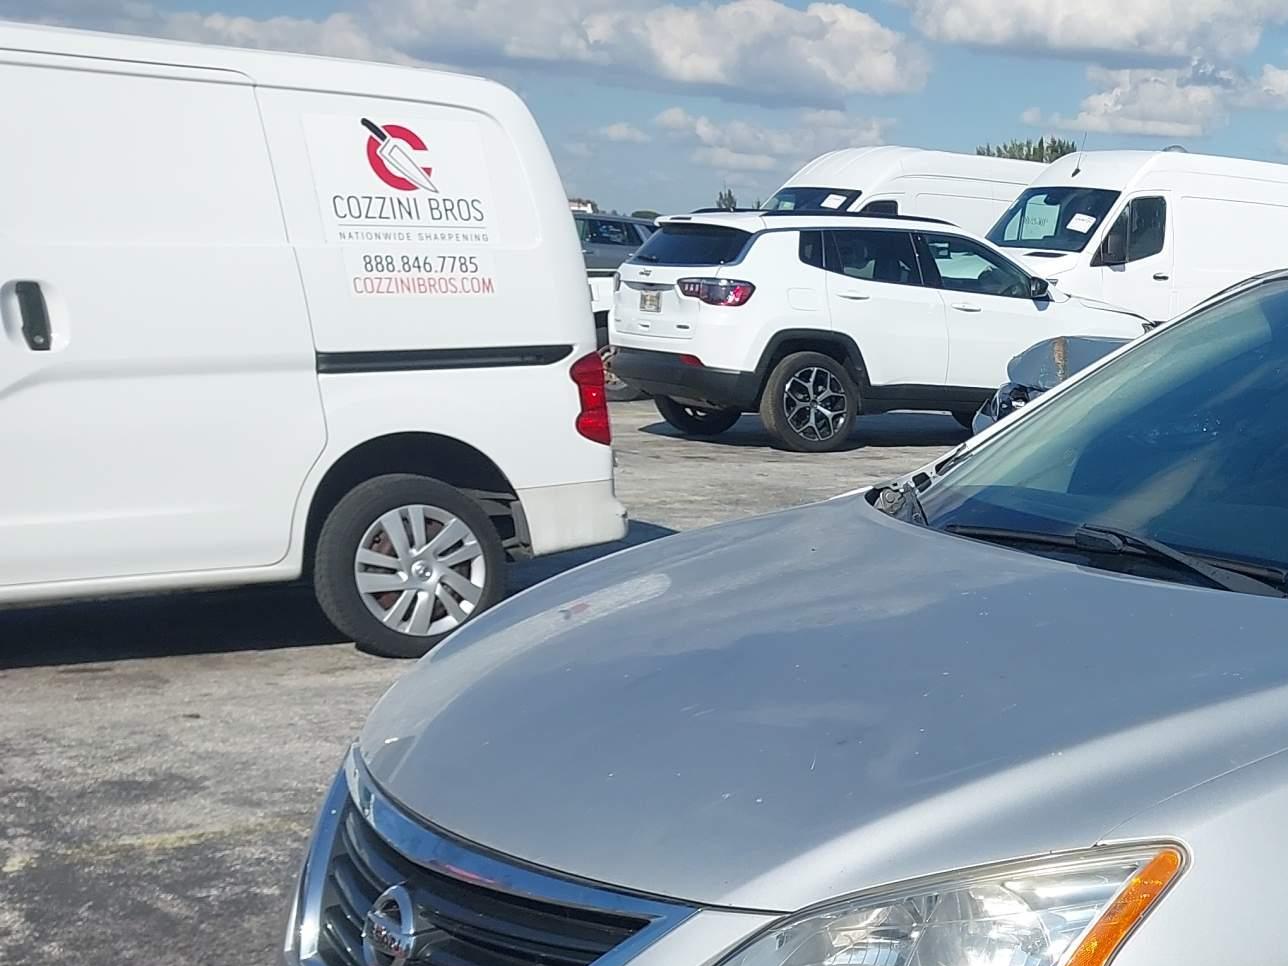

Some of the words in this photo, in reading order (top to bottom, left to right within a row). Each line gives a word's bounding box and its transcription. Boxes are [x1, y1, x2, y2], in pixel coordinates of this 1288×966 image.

[332, 195, 420, 221] COZZINI
[428, 198, 484, 222] BROS
[339, 231, 412, 241] NATIONWIDE
[417, 232, 489, 243] SHARPENING
[363, 254, 479, 273] 888.846.7785
[352, 276, 495, 294] COZZINIBROS.COM
